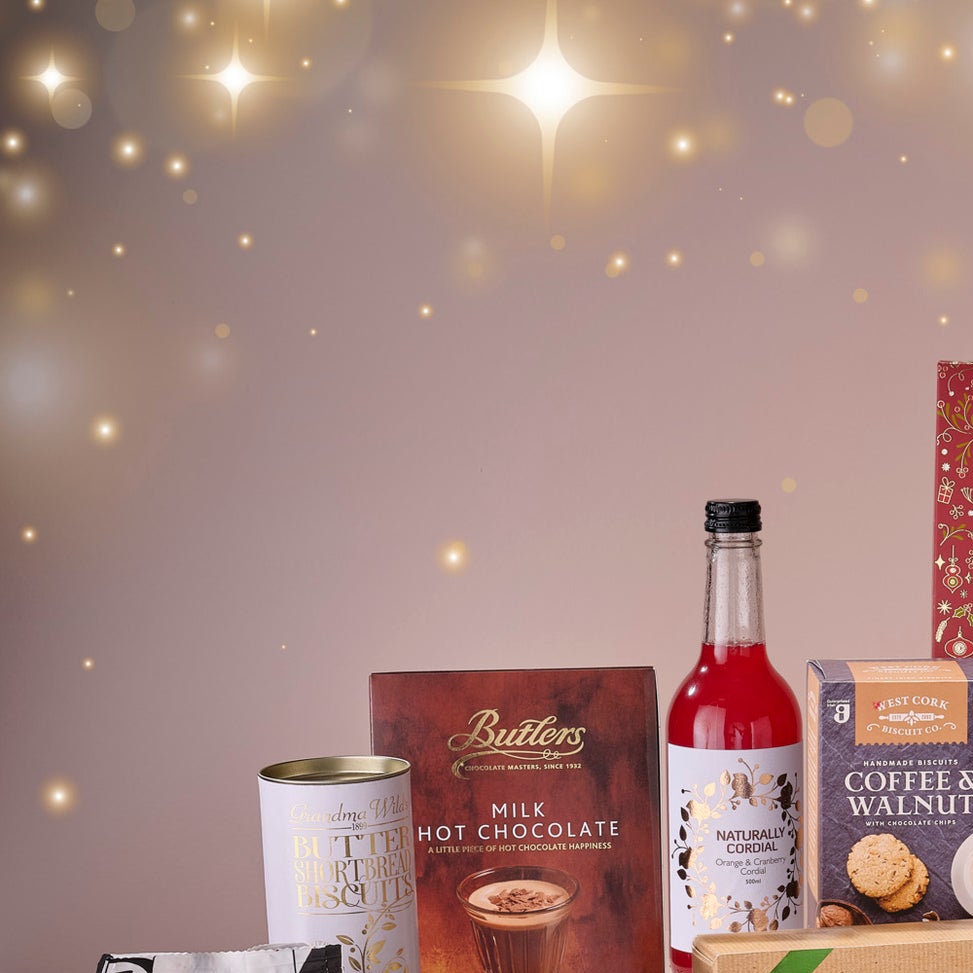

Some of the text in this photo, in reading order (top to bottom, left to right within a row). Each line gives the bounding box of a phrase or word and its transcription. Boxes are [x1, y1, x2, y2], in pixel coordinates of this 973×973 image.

[876, 695, 950, 712] WEST CORK
[447, 708, 588, 761] Butlers
[464, 764, 506, 772] CHOCOLATE
[565, 762, 582, 770] 1932
[844, 770, 951, 792] COFFEE
[289, 802, 367, 824] Grandma
[491, 801, 546, 819] MILK
[417, 820, 620, 842] HOT CHOCOLATE
[716, 826, 785, 841] NATURALLY
[292, 825, 411, 860] BUTTER
[427, 846, 434, 854] A
[435, 846, 461, 854] LITTLE
[461, 845, 484, 853] PIECE
[498, 844, 517, 852] HOT
[518, 843, 567, 851] CHOCOLATE
[568, 842, 612, 850] HAPPINESS
[726, 841, 778, 854] CORDIAL
[293, 850, 412, 884] SHORTBREAD
[715, 858, 744, 867] Orange
[754, 857, 786, 867] Cranberry
[740, 867, 766, 876] Cordial
[296, 873, 414, 910] BISCUITS
